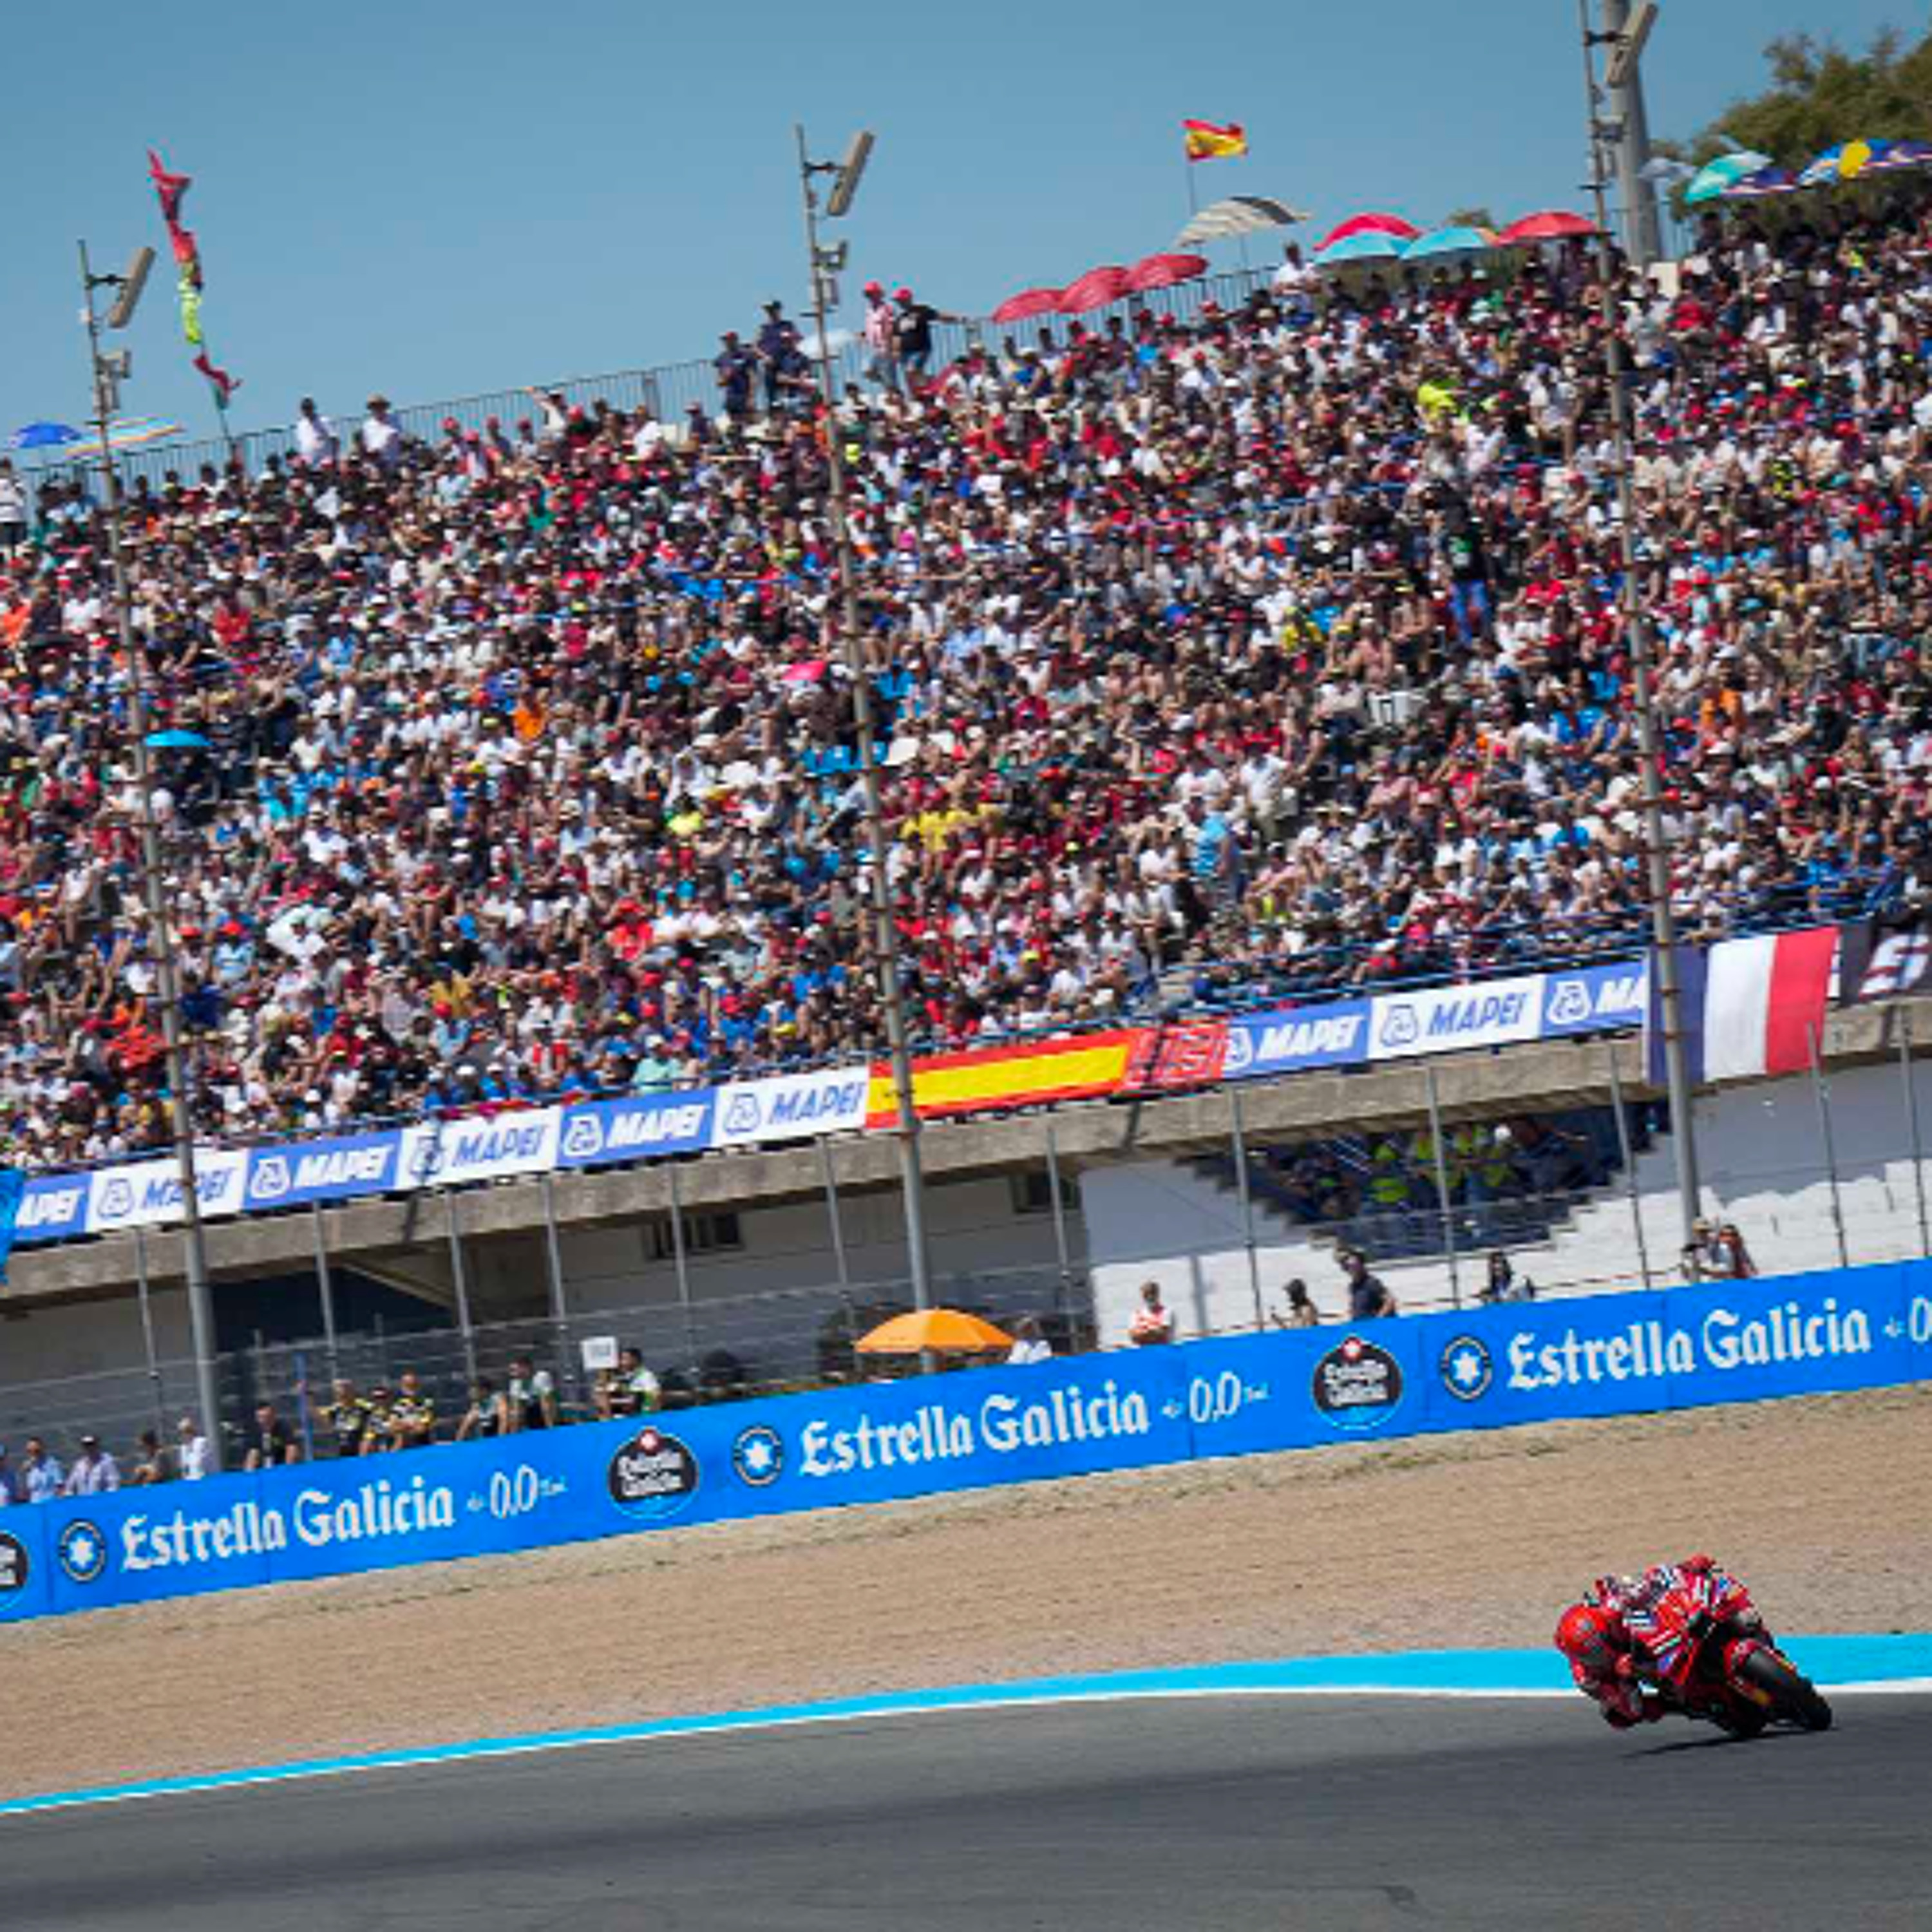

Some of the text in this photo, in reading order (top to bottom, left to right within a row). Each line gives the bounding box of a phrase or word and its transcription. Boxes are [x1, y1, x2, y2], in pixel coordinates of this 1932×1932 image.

[1428, 992, 1527, 1036] MAPEI
[1256, 1016, 1365, 1060] MAPEI
[769, 1083, 865, 1124] MAPEI
[452, 1124, 547, 1166] MAPEI
[606, 1104, 708, 1148] MAPEI
[293, 1144, 394, 1188] MAPEI
[15, 1189, 84, 1229] APEI
[142, 1168, 236, 1209] MAEI
[1508, 1321, 1696, 1390] Estrella
[1703, 1298, 1871, 1370] Galicia
[799, 1406, 974, 1477] Estrella
[981, 1379, 1151, 1452] Galicia
[120, 1501, 287, 1573] Estrella
[294, 1475, 455, 1546] Galicia
